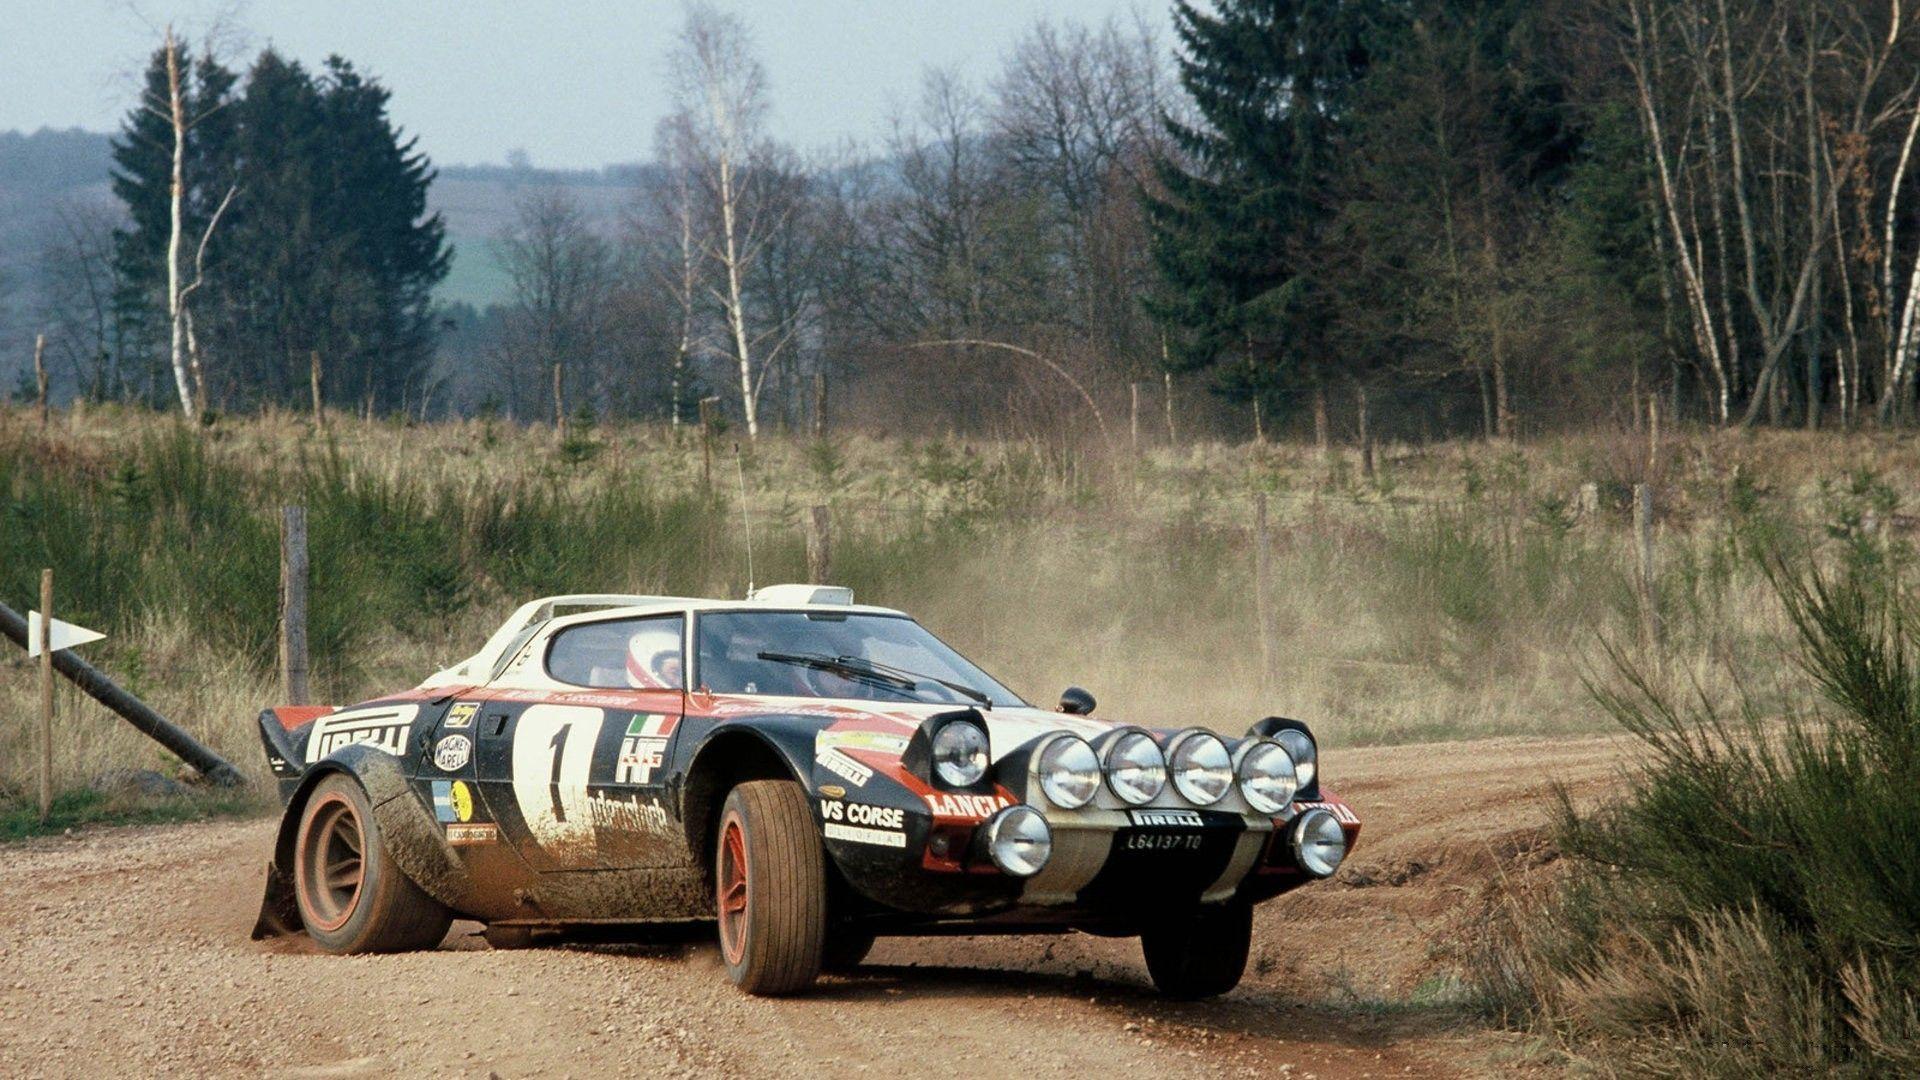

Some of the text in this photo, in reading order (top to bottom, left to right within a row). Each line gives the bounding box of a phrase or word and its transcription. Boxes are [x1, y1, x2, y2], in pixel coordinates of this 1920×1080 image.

[305, 704, 420, 764] PIRELLI
[549, 723, 573, 822] 1
[615, 737, 668, 784] HF
[816, 747, 873, 787] PIRELLI
[821, 799, 904, 828] VS CORSE
[1130, 809, 1204, 827] PIRELLI
